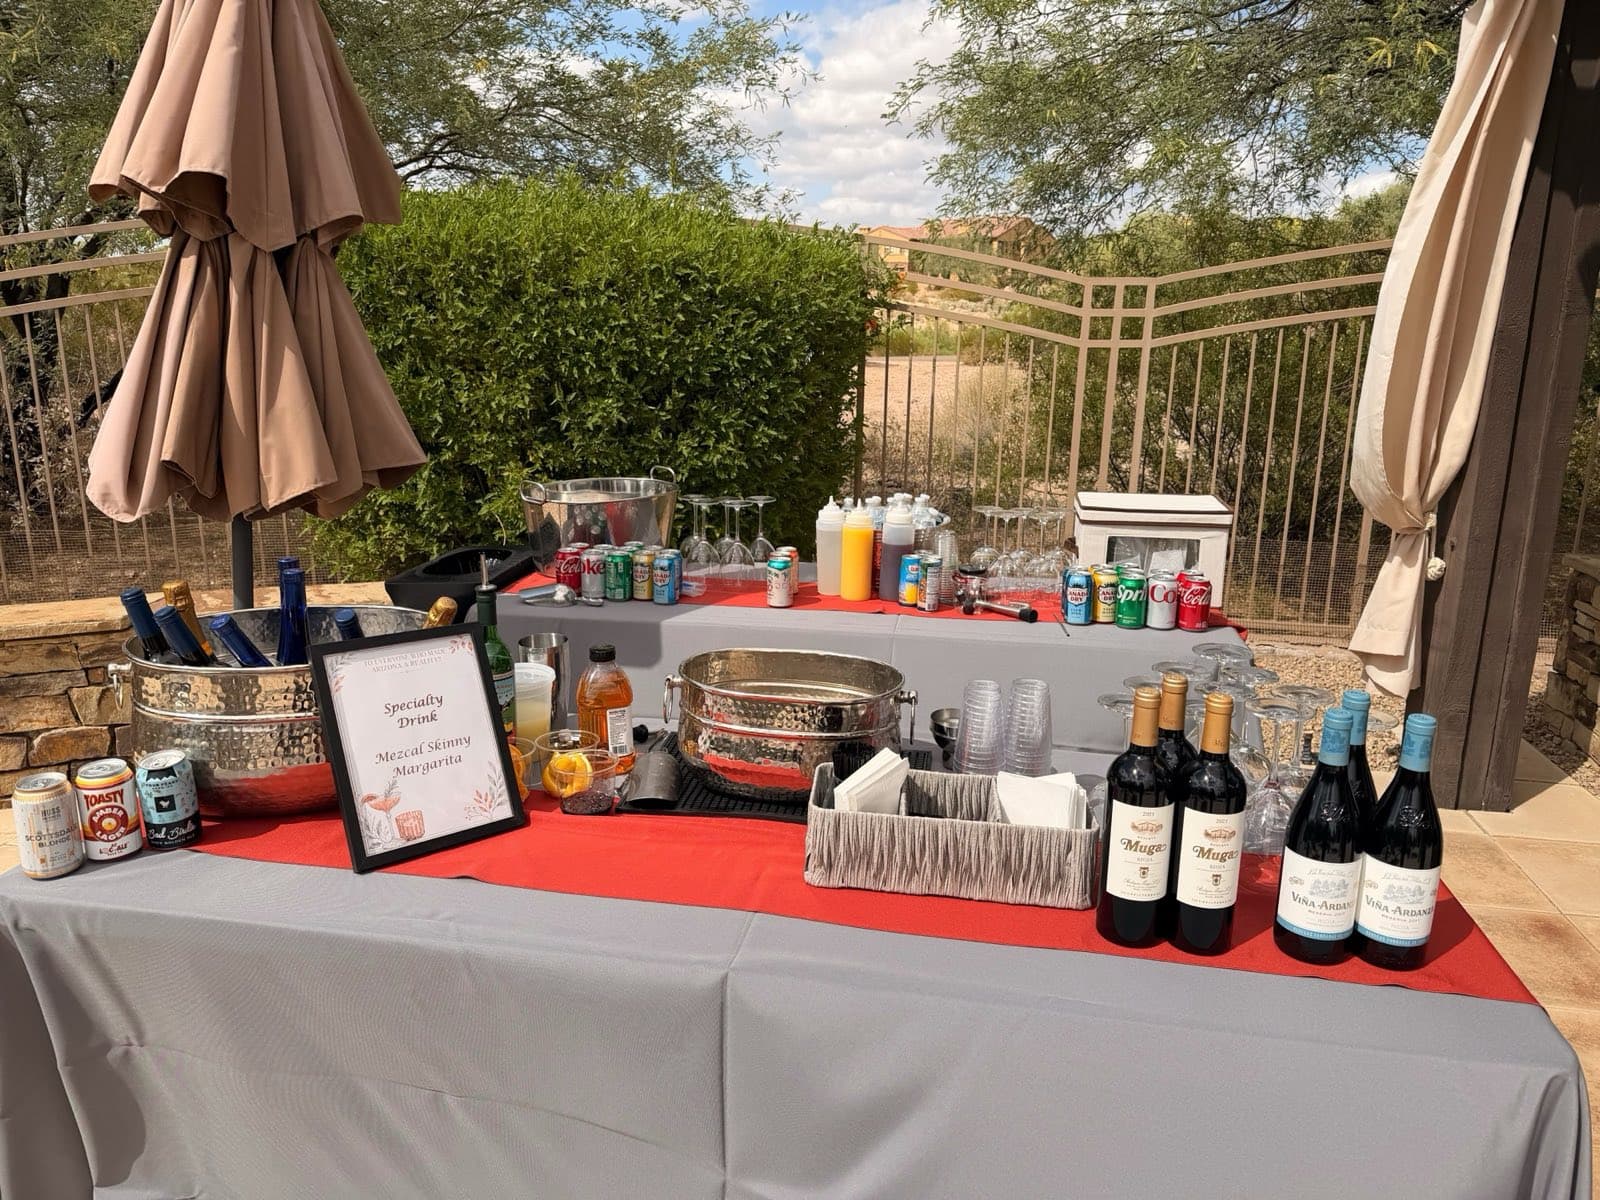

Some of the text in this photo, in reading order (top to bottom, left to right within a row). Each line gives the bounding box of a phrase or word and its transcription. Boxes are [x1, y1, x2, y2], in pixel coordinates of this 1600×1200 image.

[1149, 584, 1177, 604] Co
[384, 693, 443, 718] Specialty
[397, 709, 439, 729] Drink
[375, 735, 471, 765] Mezcal Skinny
[392, 754, 463, 779] Margarita
[83, 788, 125, 811] TOASTY
[92, 807, 124, 823] AMBER
[95, 826, 126, 842] LAGER
[1120, 838, 1168, 856] Muga
[1192, 845, 1239, 863] Muga
